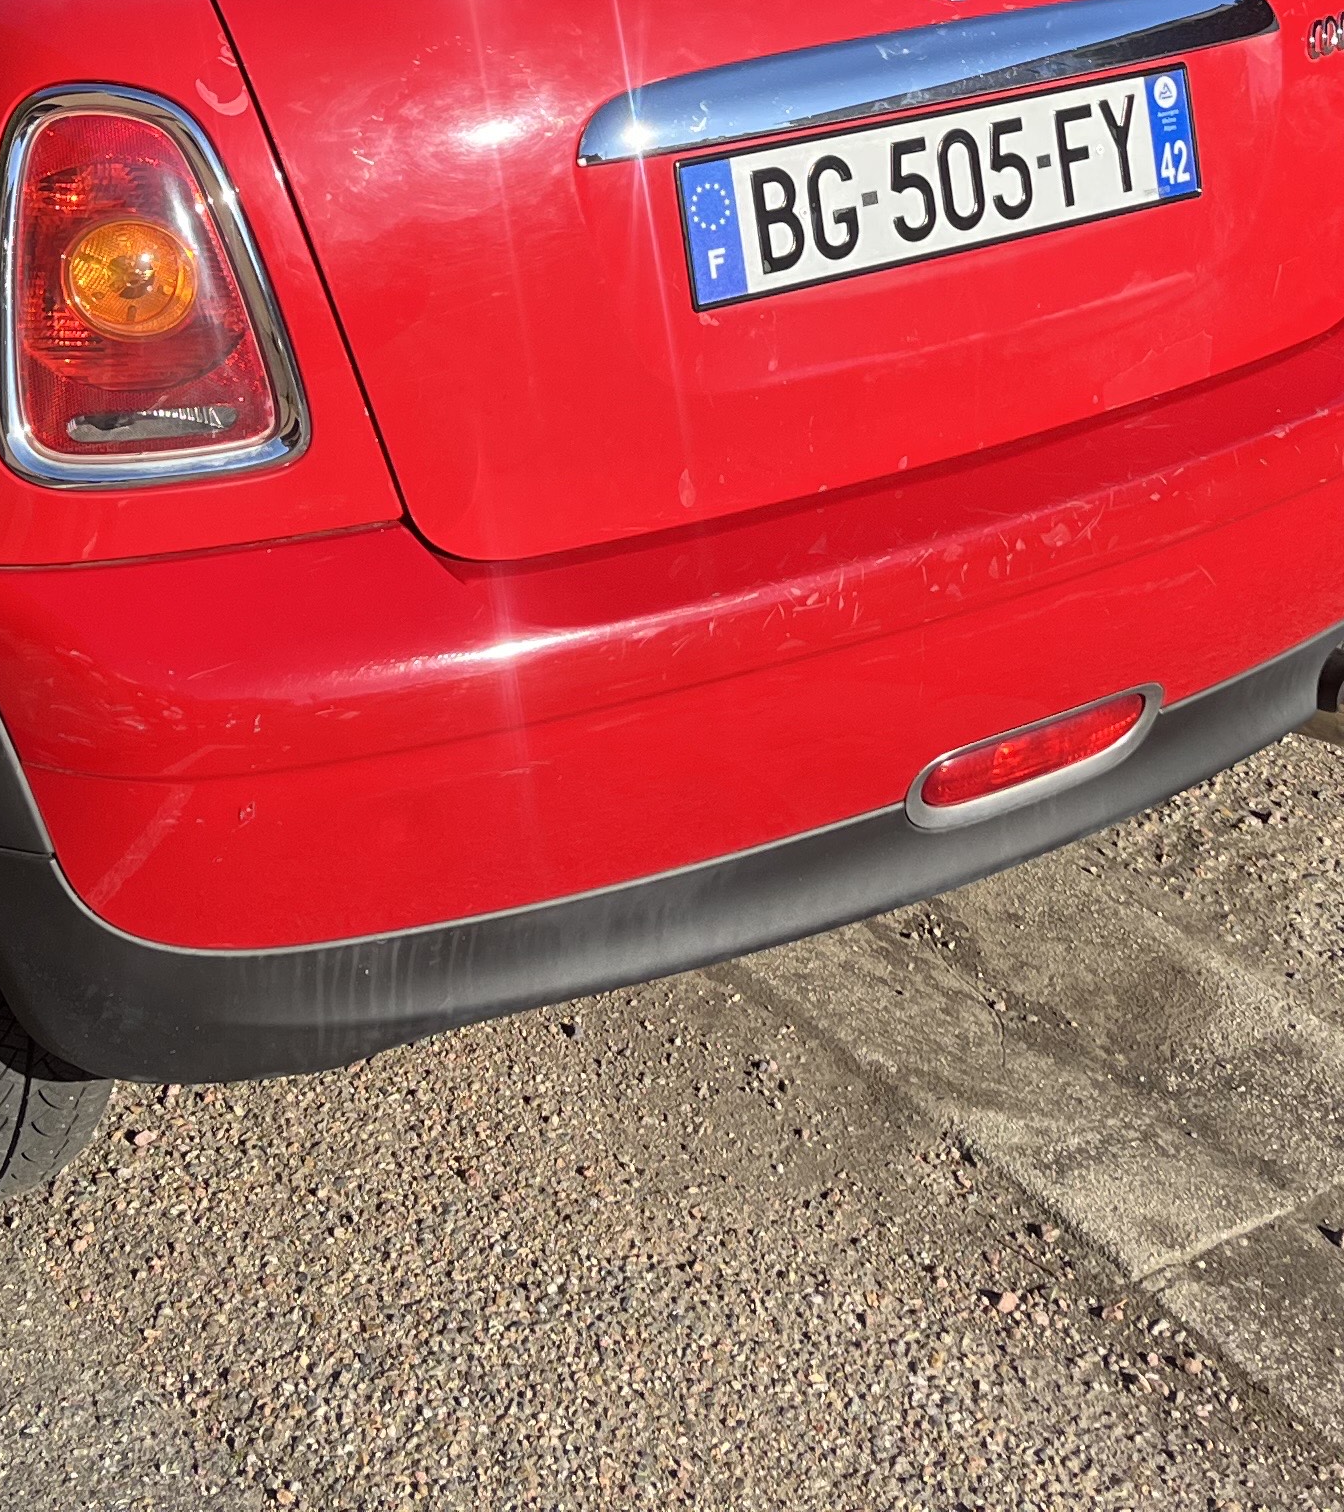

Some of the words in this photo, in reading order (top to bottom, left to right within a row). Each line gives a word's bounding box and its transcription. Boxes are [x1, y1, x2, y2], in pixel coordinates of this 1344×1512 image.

[707, 246, 727, 280] F
[749, 92, 1136, 276] BG-505-FY
[1160, 139, 1191, 185] 42
